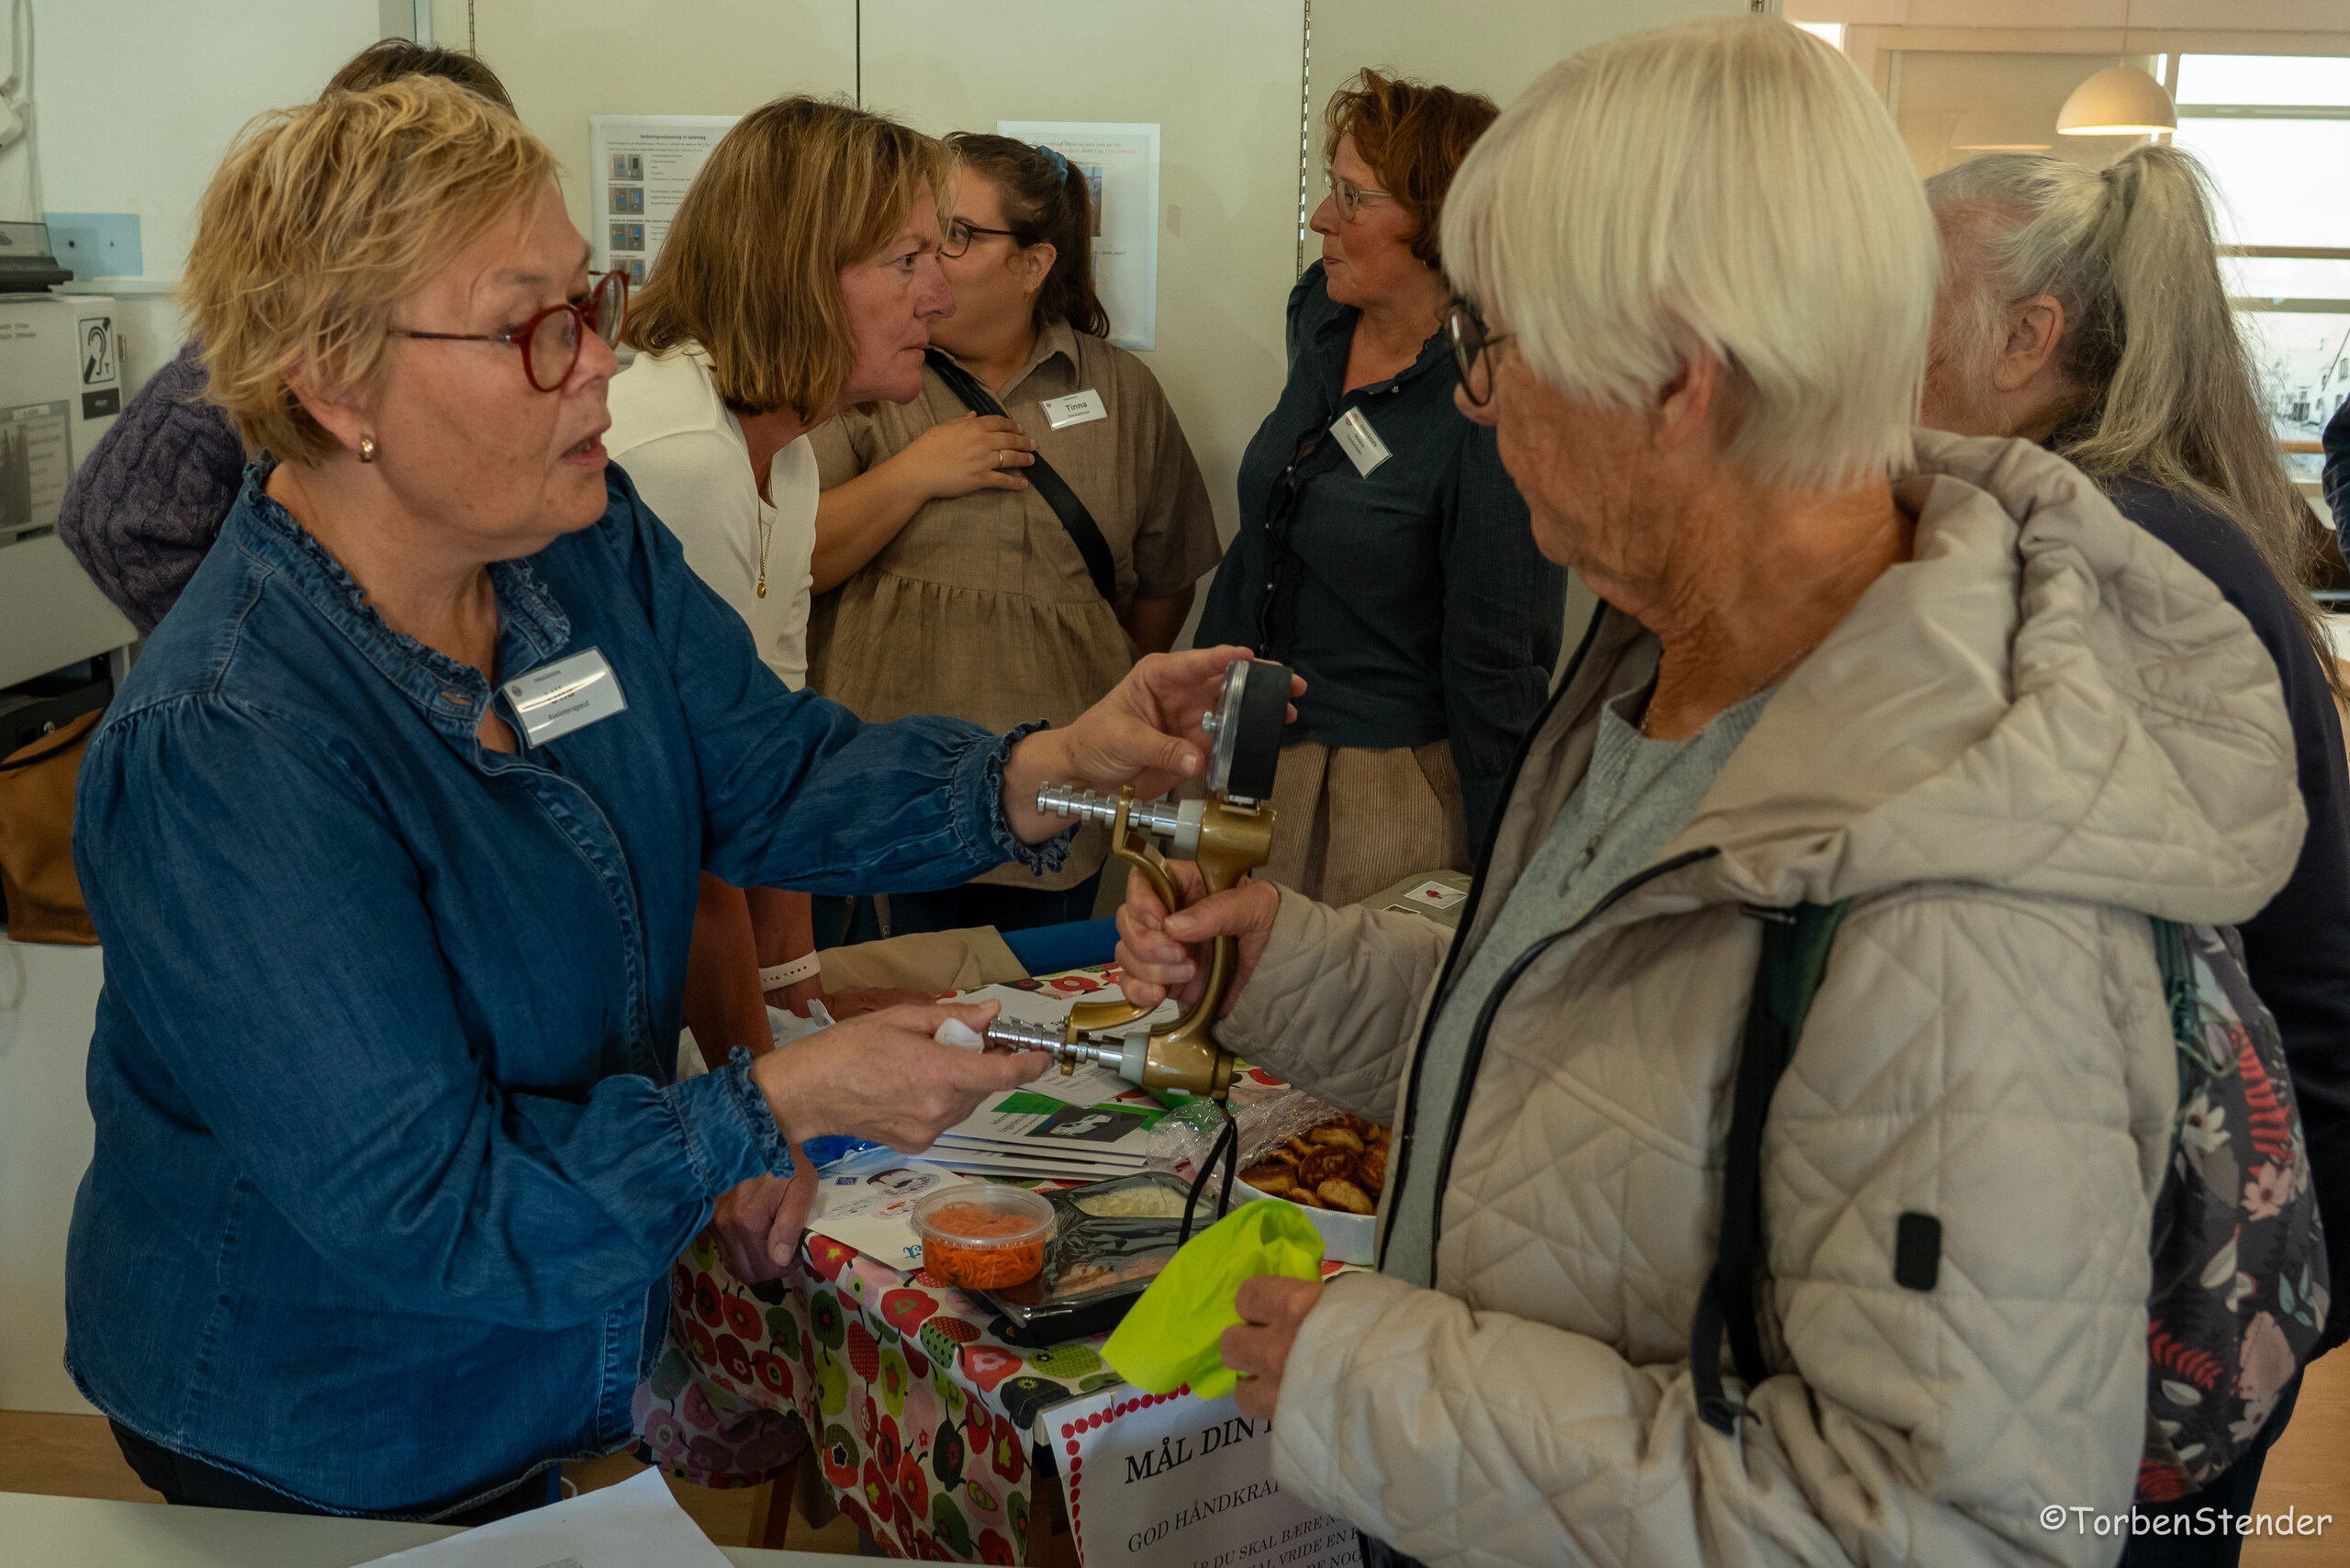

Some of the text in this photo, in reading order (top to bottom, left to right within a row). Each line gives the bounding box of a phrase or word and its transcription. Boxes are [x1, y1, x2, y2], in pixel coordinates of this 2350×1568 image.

[104, 363, 109, 374] T
[1065, 402, 1088, 412] Tinna
[548, 700, 590, 721] Fysioterapeut
[1125, 1417, 1255, 1484] MÅL DIN
[1128, 1520, 1169, 1552] GOD
[1214, 1551, 1236, 1568] DU
[1239, 1536, 1278, 1560] SKAL
[1281, 1517, 1322, 1543] BÆRE
[1280, 1539, 1322, 1565] VRIDE
[1327, 1529, 1346, 1548] EN
